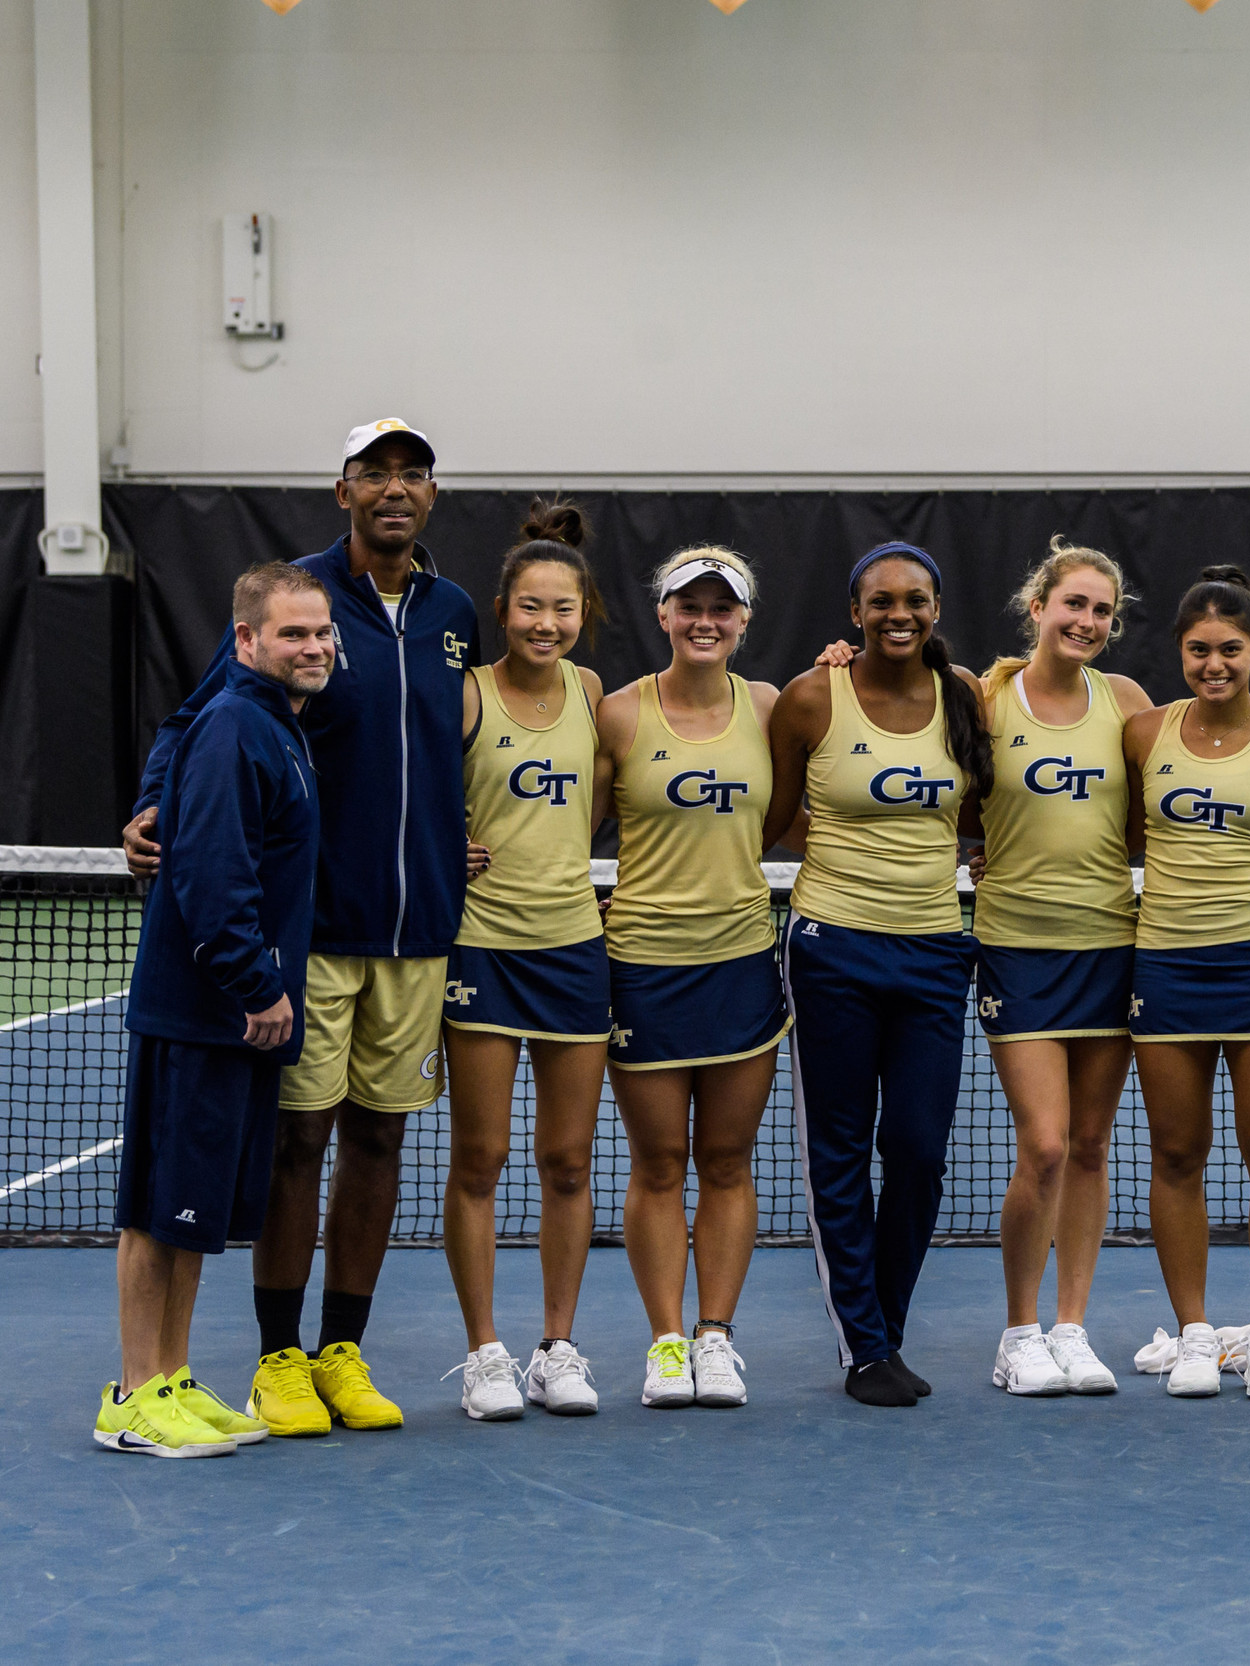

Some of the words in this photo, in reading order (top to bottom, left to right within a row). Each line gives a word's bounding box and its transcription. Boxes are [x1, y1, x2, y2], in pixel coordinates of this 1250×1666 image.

[702, 560, 725, 573] GT
[443, 631, 468, 659] GT
[508, 758, 578, 807] GT
[665, 768, 749, 815] GT
[868, 765, 956, 810] GT
[1023, 755, 1106, 802] GT
[1159, 786, 1247, 832] GT
[444, 979, 477, 1006] GT
[979, 995, 1003, 1019] GT
